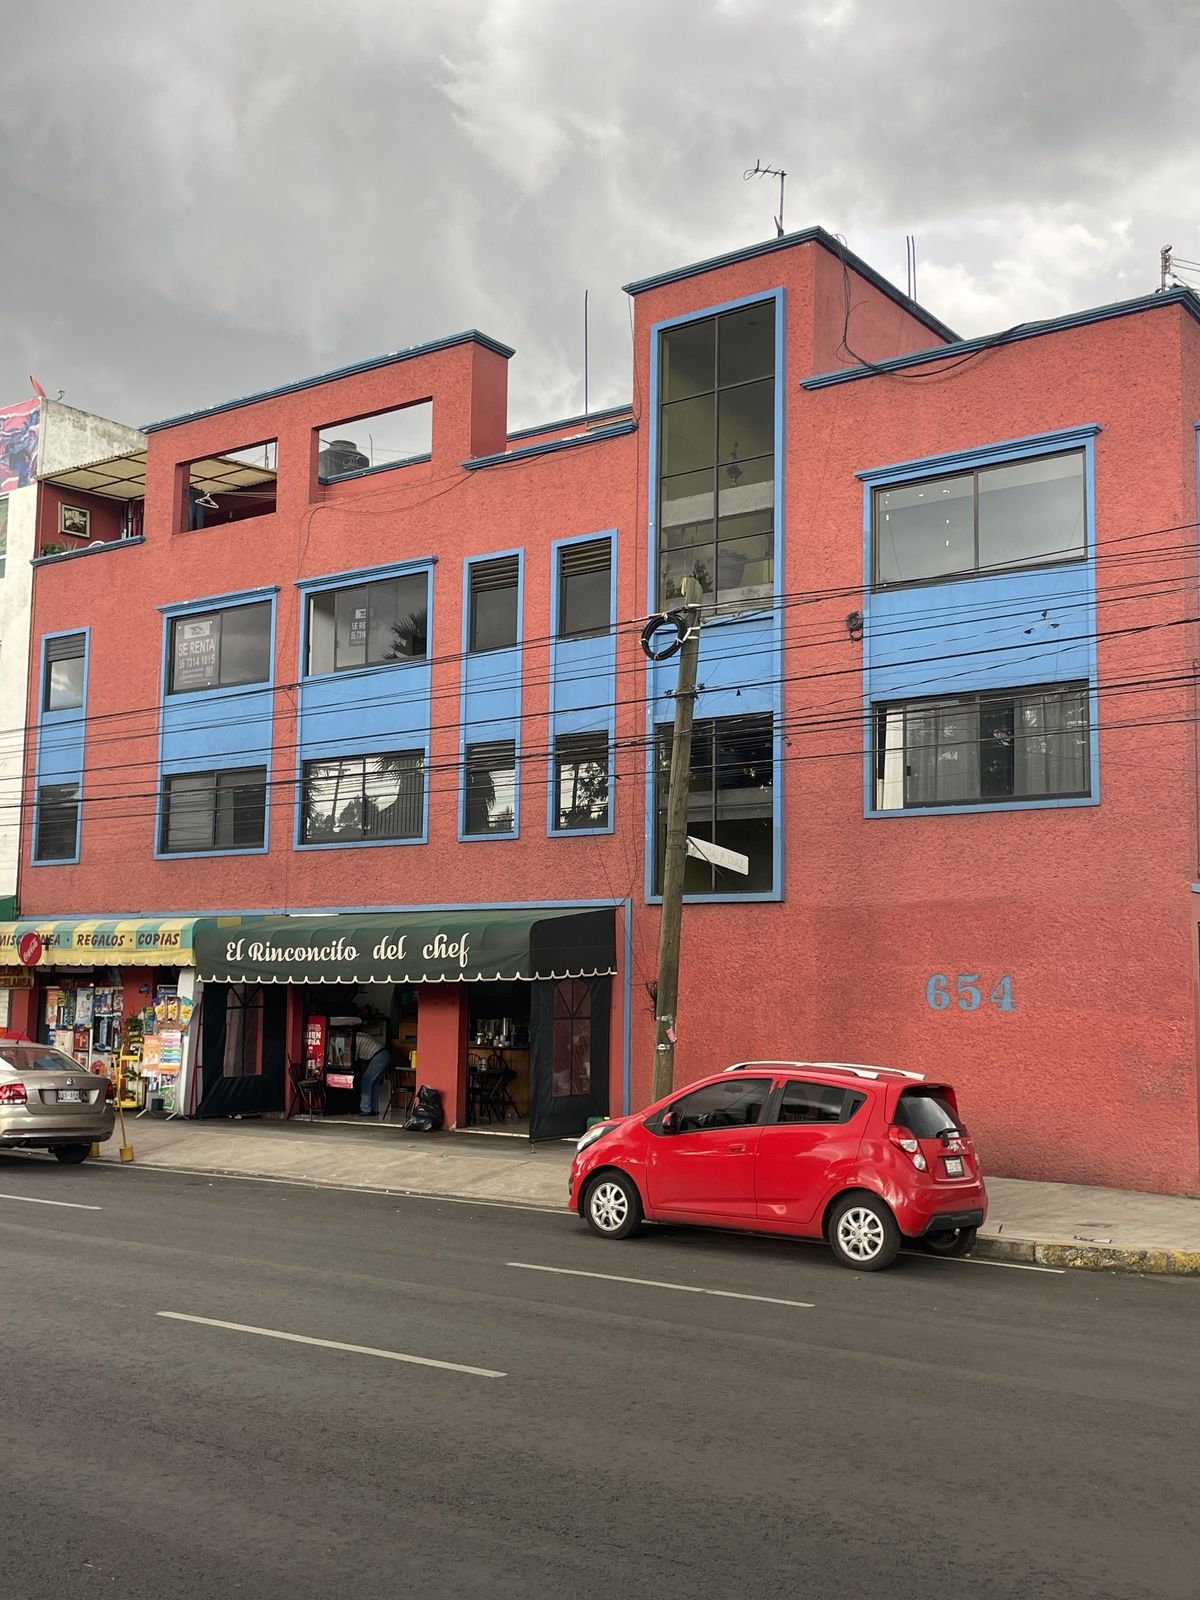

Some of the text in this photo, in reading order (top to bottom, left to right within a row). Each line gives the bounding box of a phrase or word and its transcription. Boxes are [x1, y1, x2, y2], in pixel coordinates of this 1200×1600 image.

[178, 638, 215, 656] SE RENTA
[77, 934, 125, 946] REGALOS
[138, 933, 180, 946] COPIAS
[226, 932, 470, 968] El Rinconcito del chef
[926, 972, 1016, 1012] 654
